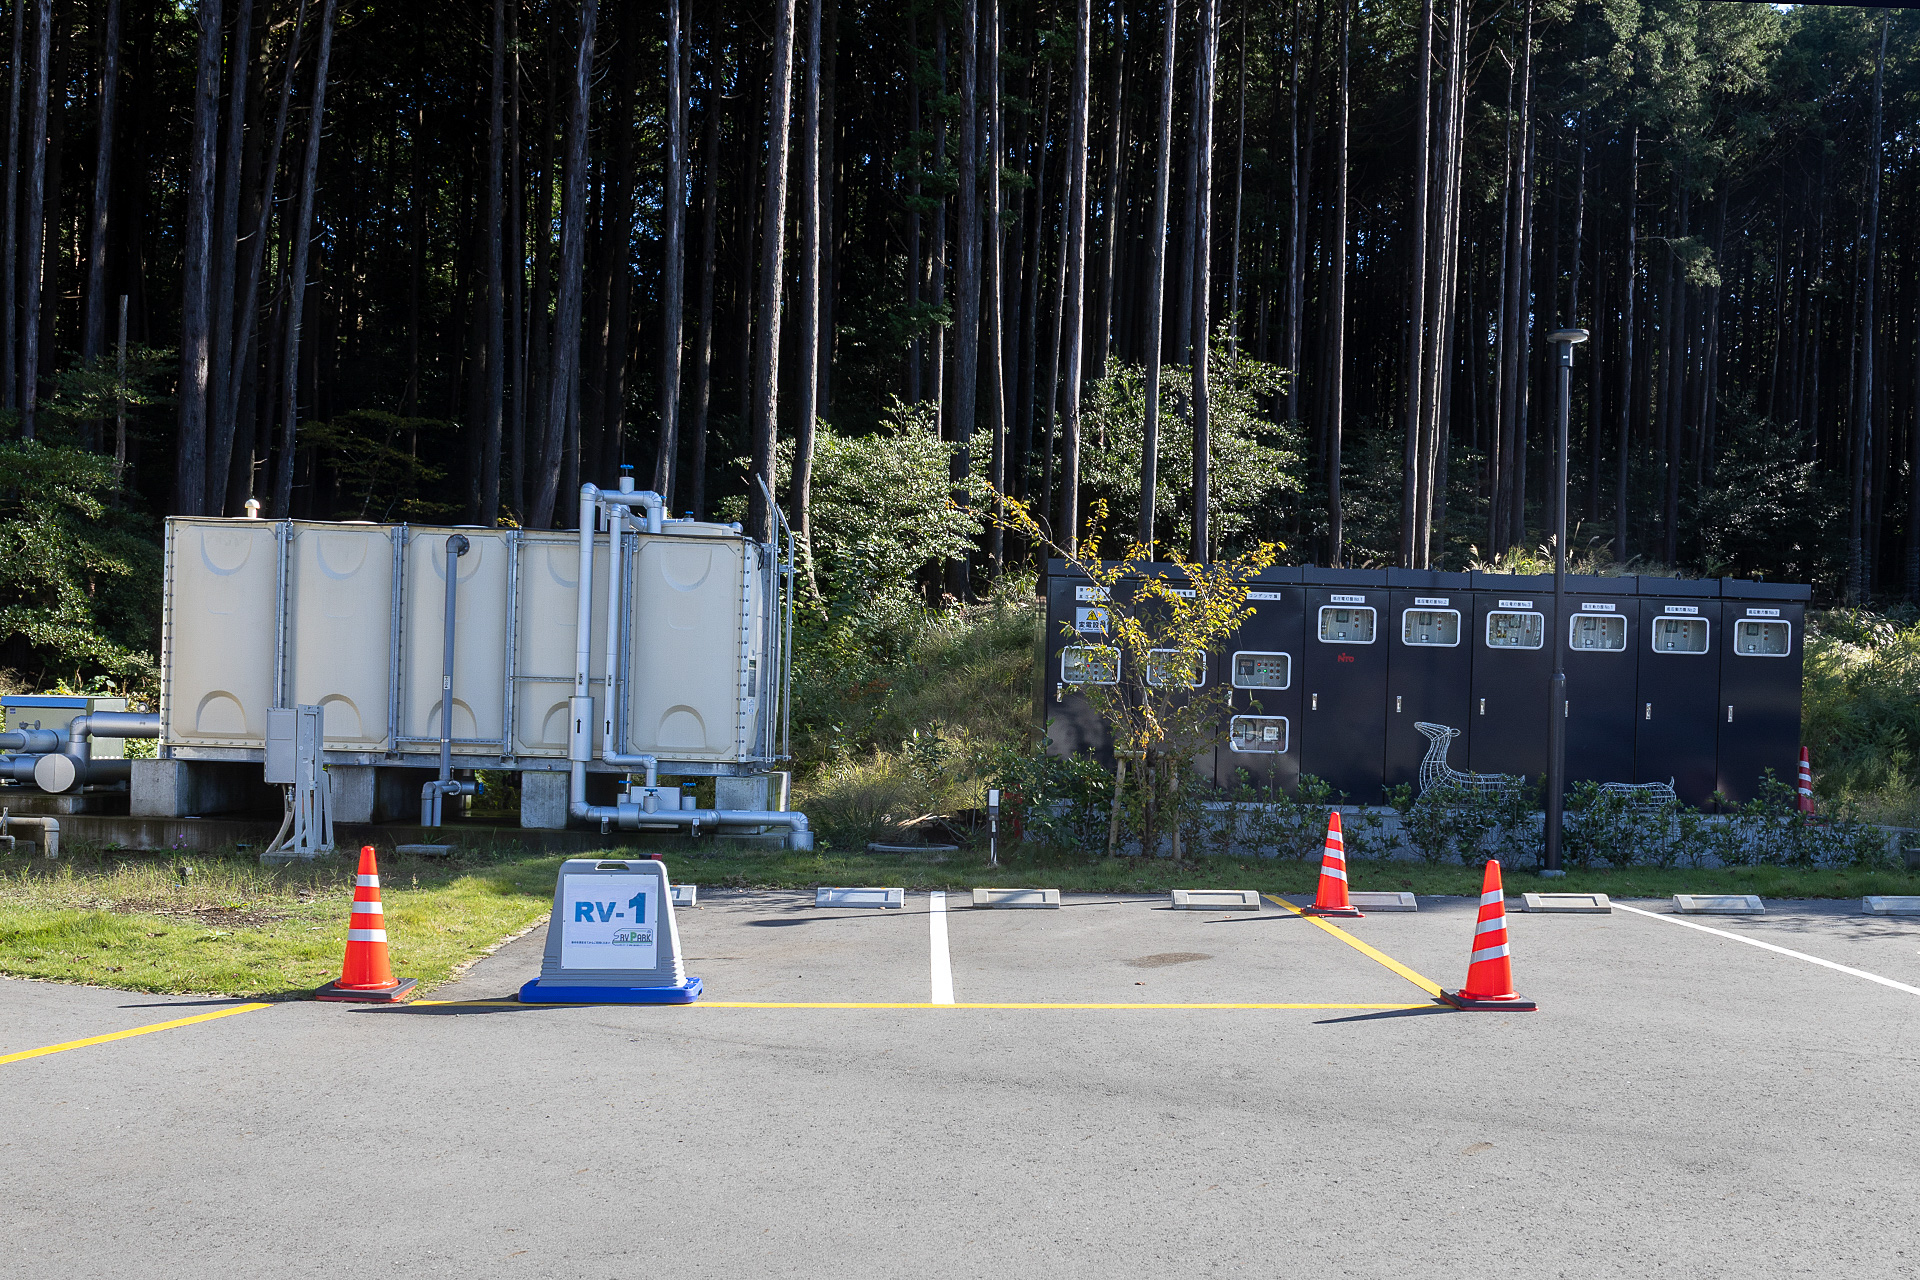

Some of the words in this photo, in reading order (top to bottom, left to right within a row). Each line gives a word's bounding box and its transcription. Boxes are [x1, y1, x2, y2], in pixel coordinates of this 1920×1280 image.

[574, 892, 647, 924] RV-1
[620, 933, 629, 942] RV
[630, 931, 652, 943] PARK
